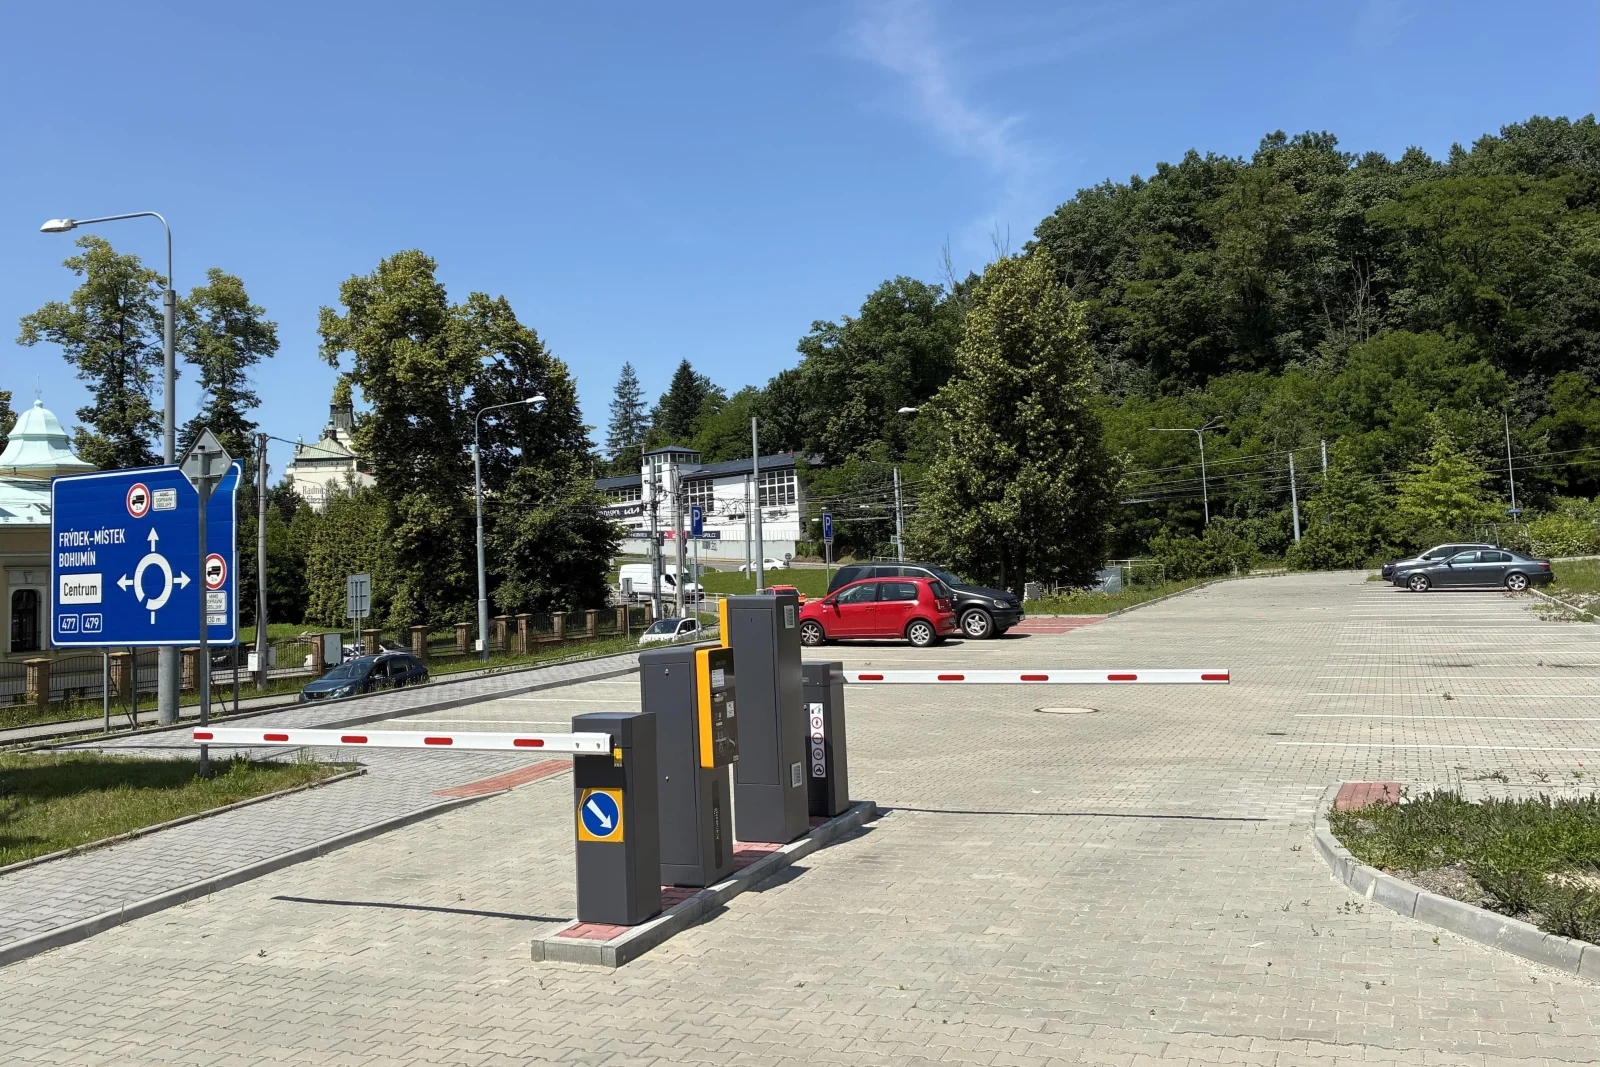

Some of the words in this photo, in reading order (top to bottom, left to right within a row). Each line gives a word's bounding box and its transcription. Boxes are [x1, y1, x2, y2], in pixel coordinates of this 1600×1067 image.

[693, 509, 701, 527] P
[59, 526, 125, 547] FRÝDEK-MÍSTEK
[59, 547, 96, 567] BOHUMÍN
[63, 582, 98, 597] Centrum
[61, 617, 76, 630] 477
[84, 617, 99, 629] 479
